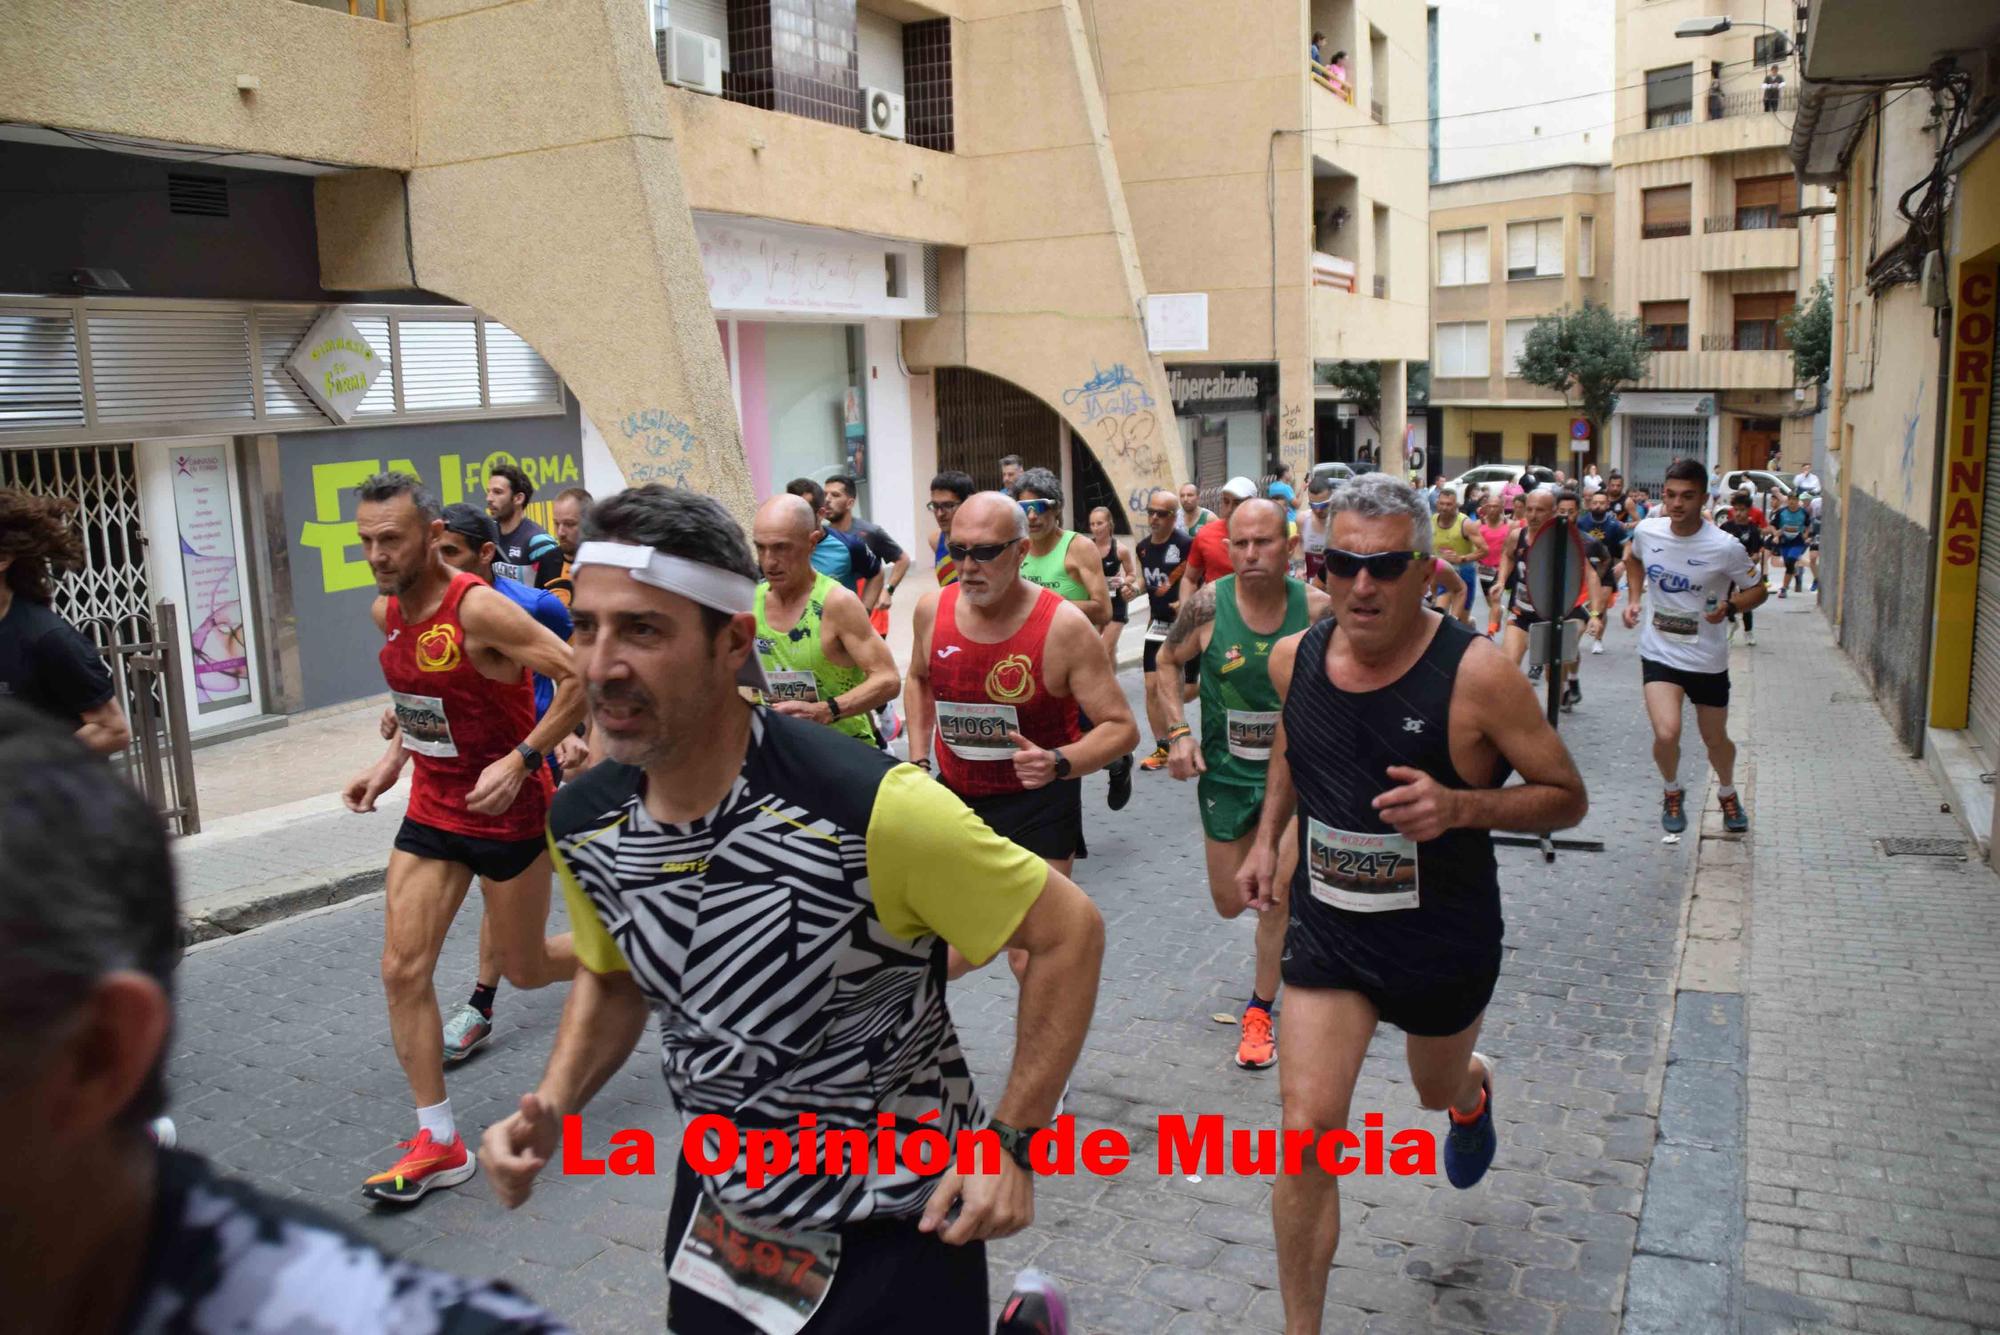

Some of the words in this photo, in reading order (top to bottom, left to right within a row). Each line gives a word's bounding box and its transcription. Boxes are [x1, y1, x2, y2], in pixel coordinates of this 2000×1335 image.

[1166, 370, 1258, 409] Hipercalzados
[1946, 274, 1992, 566] CORTINAS
[949, 716, 1007, 736] 1061
[1318, 846, 1401, 879] 1247
